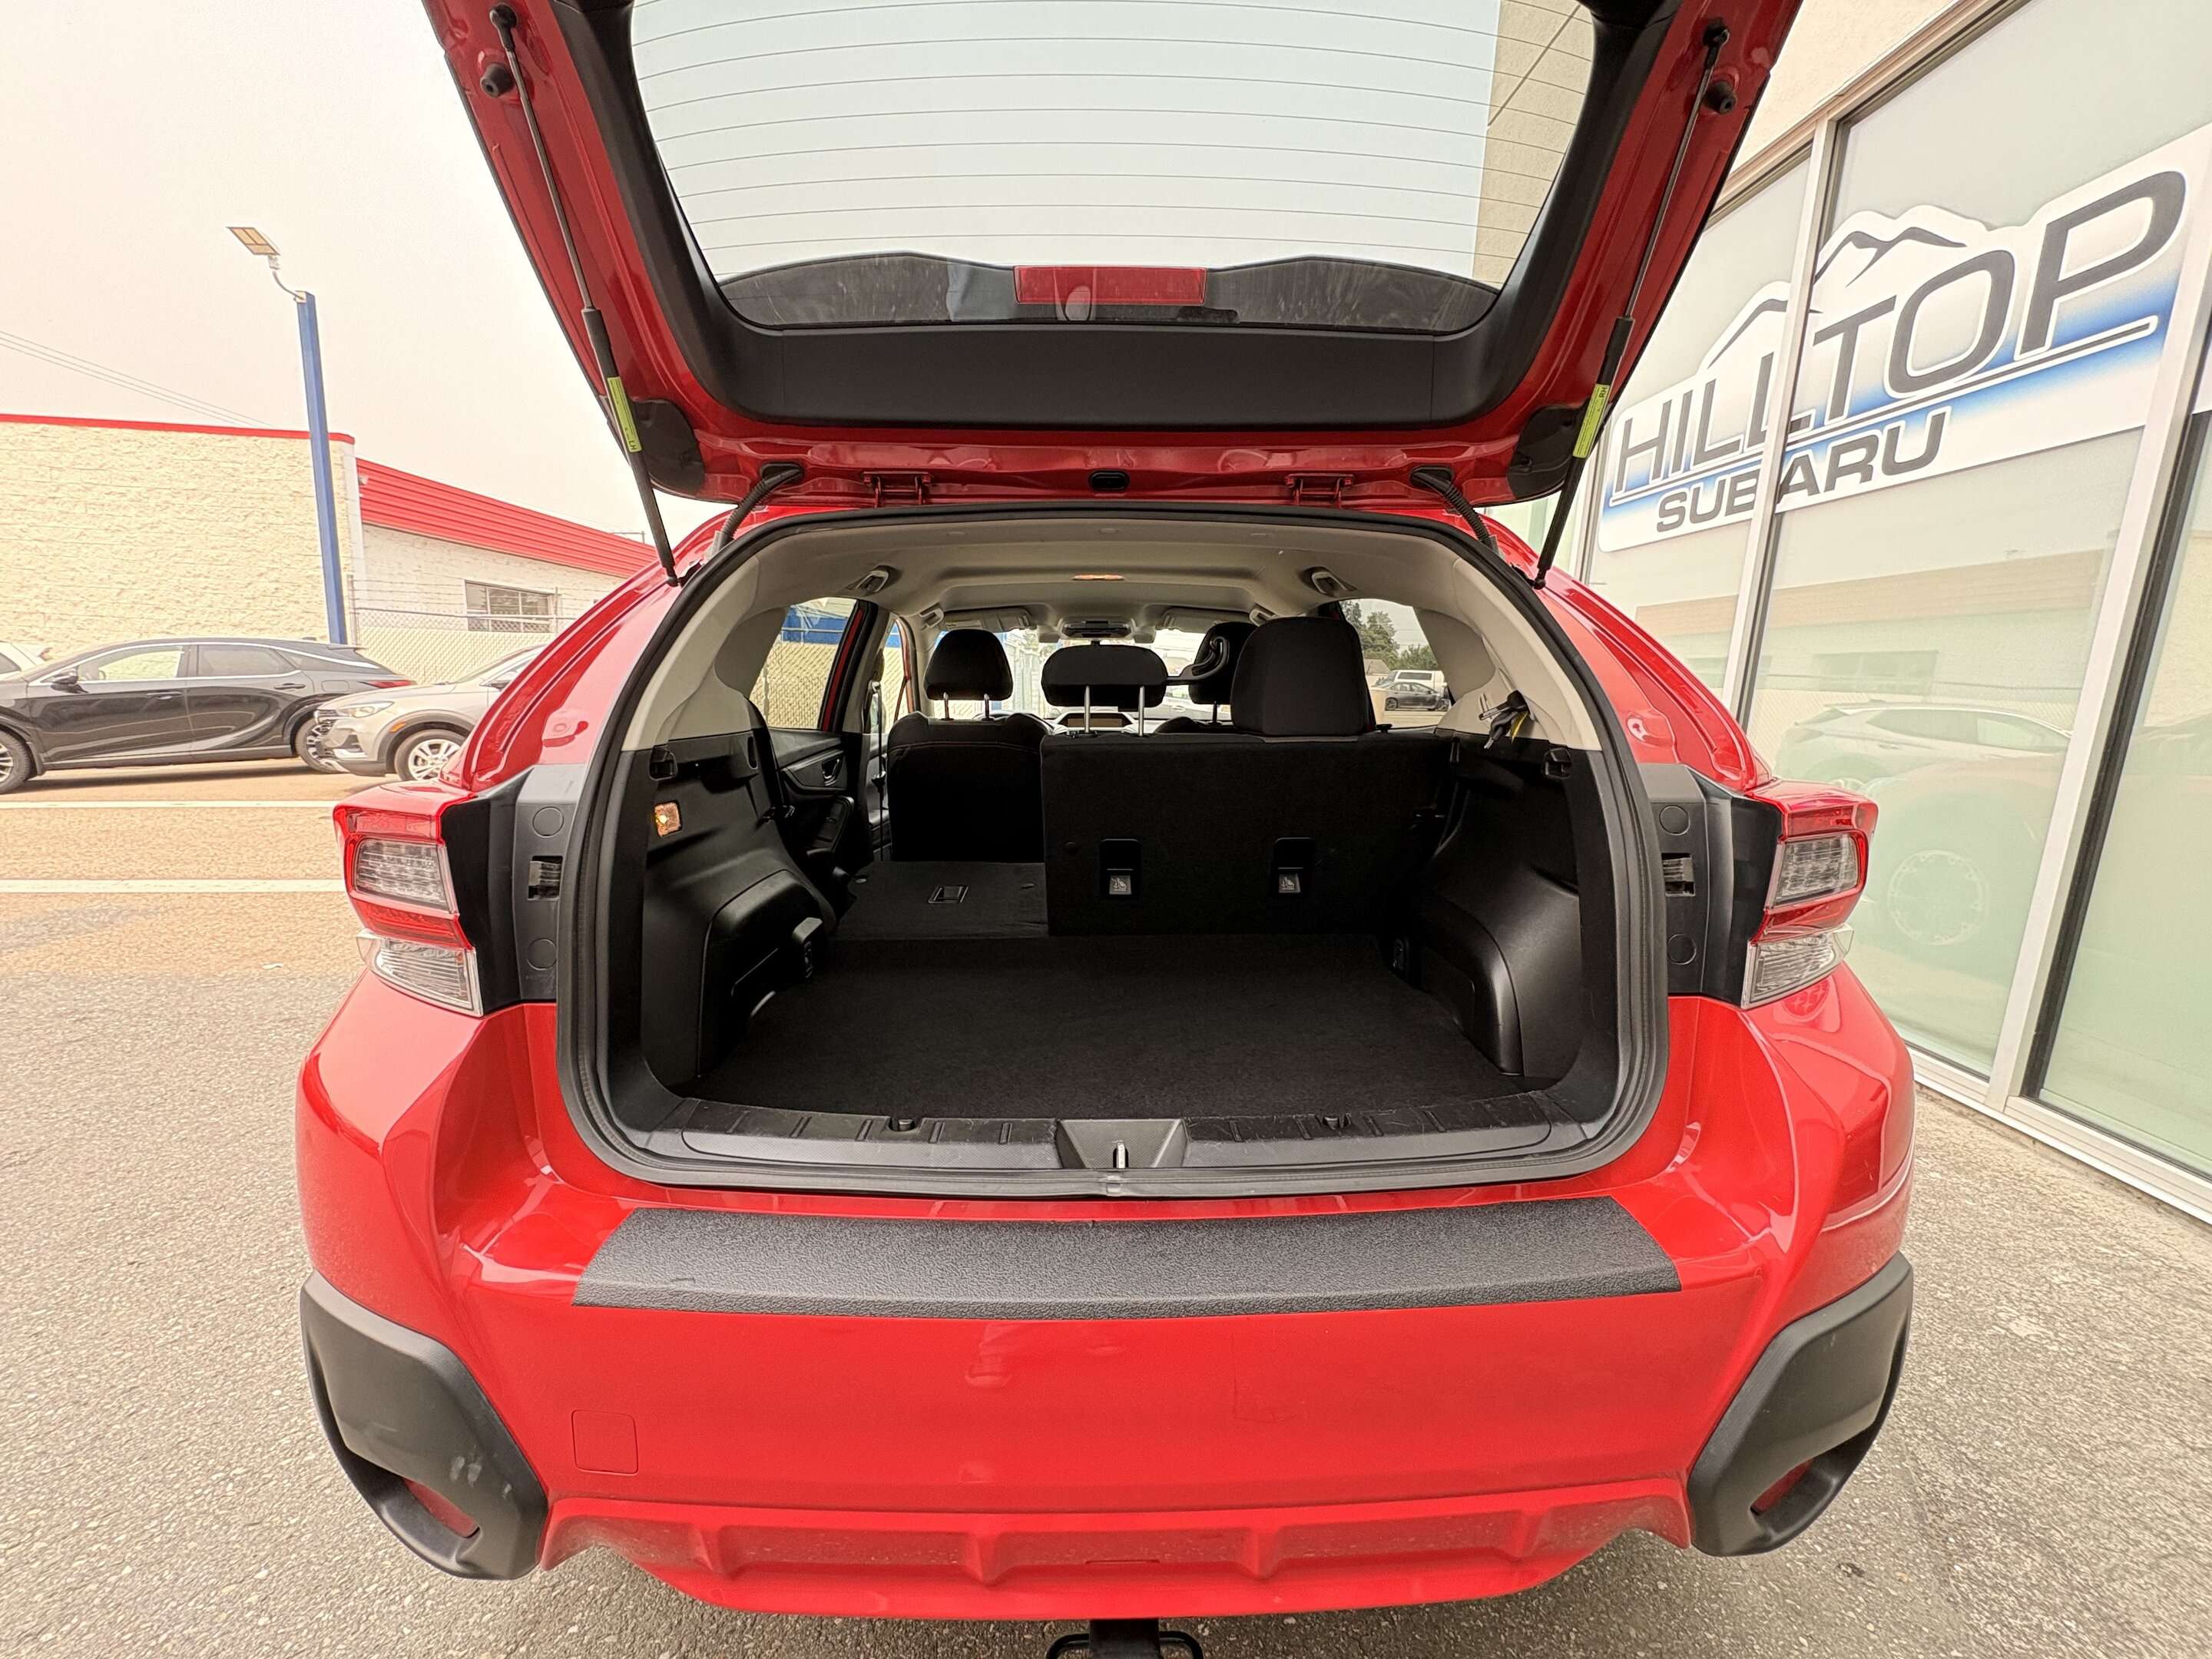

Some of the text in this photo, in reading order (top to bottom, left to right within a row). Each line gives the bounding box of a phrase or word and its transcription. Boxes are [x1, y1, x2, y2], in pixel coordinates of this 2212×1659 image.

[1614, 171, 2187, 494] HILLTOP
[1598, 386, 1608, 399] RH
[628, 439, 637, 450] LH
[1656, 413, 1946, 532] SUBARU
